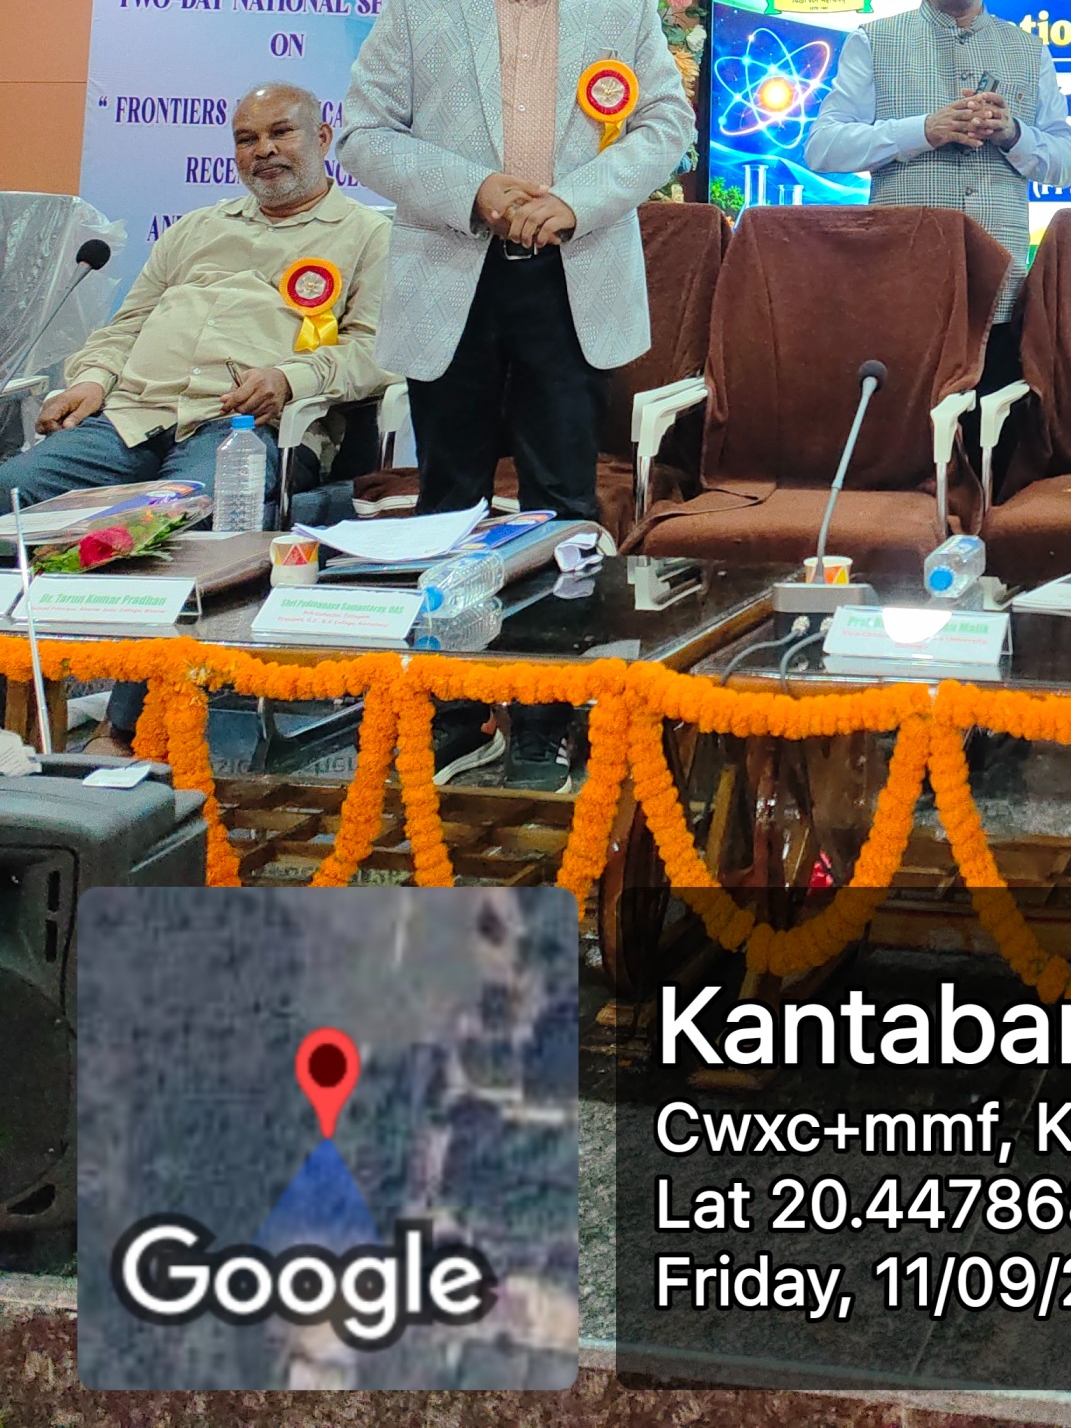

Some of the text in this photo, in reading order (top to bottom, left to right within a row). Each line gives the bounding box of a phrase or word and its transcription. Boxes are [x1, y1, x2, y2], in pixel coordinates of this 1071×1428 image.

[270, 32, 305, 58] ON
[115, 96, 227, 125] FRONTIERS
[185, 156, 240, 184] RECE
